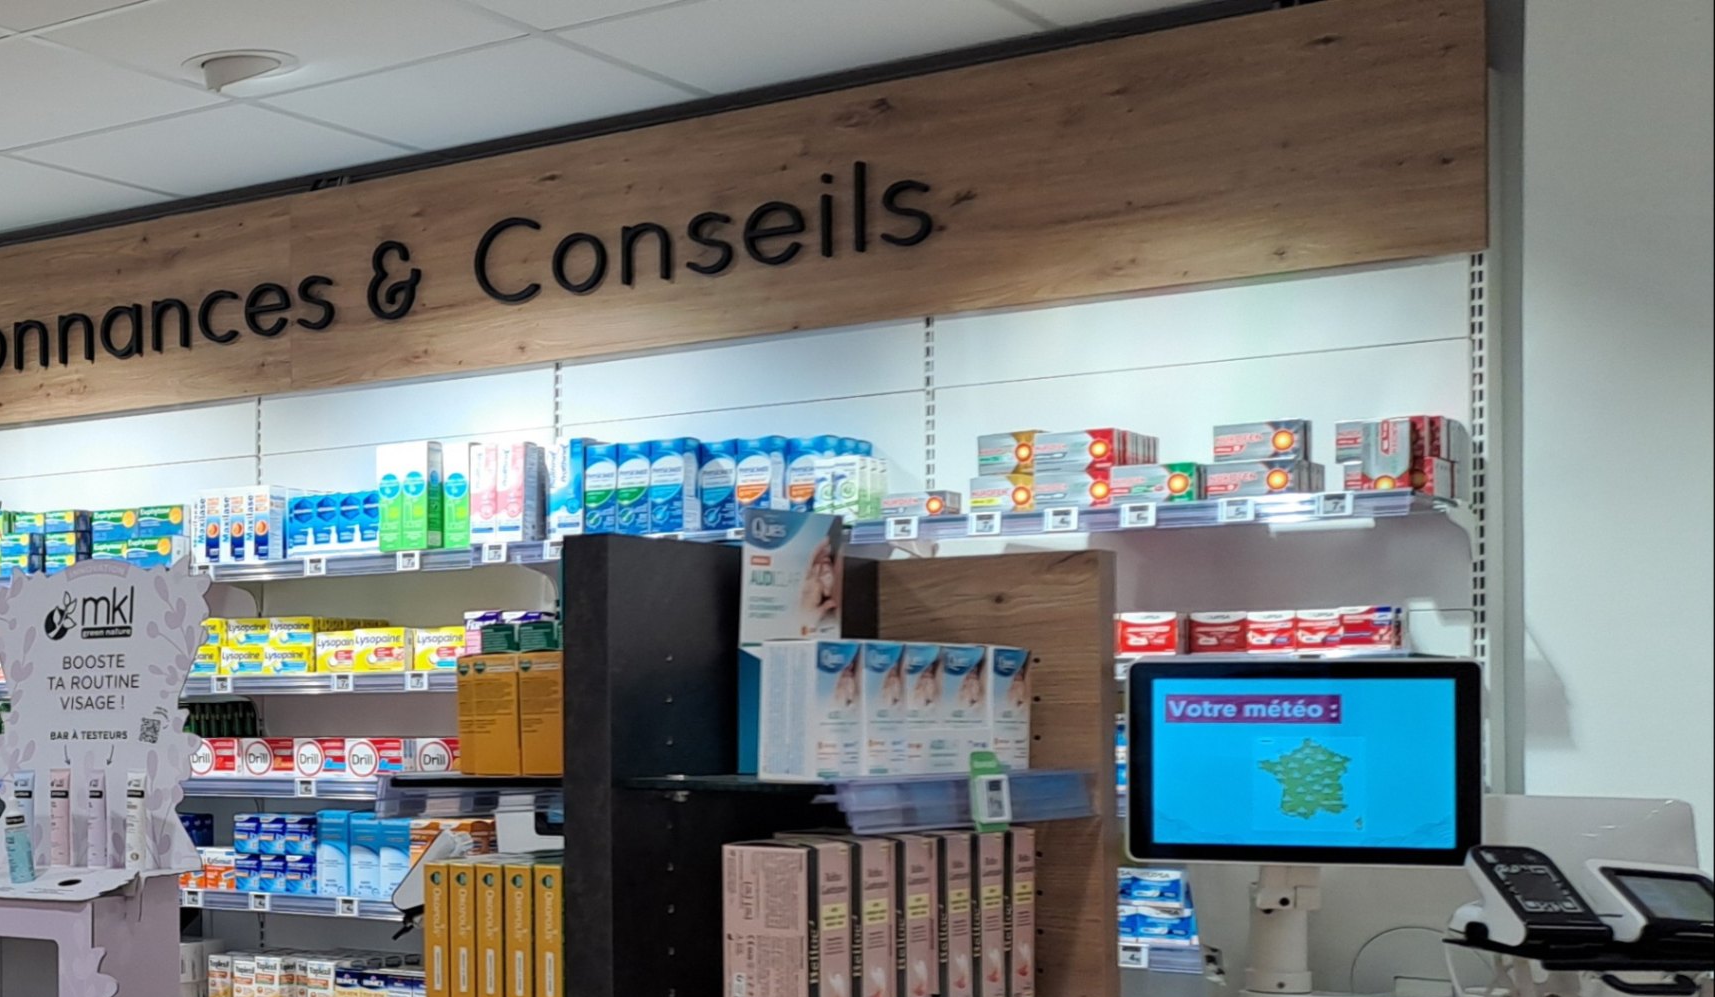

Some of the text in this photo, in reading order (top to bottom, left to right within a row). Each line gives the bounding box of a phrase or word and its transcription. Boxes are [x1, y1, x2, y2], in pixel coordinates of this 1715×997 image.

[366, 238, 422, 322] &
[474, 160, 934, 306] Conseils
[81, 585, 135, 627] mkl
[82, 626, 132, 638] green nature
[228, 621, 267, 634] Lysopaine
[270, 620, 311, 632] Lysopaine
[317, 637, 354, 648] Lysopain
[355, 633, 402, 647] Lysopaine
[416, 632, 464, 645] Lysopaine
[62, 654, 125, 670] BOOSTE
[222, 650, 261, 662] Lysopaine
[264, 650, 305, 662] Lysopaine
[46, 673, 140, 691] TA ROUTINE
[59, 695, 125, 711] VISAGE !
[1168, 698, 1338, 718] Votre météo :
[49, 728, 128, 741] BAR À TESTEURS
[191, 753, 211, 764] Drill
[248, 751, 269, 764] Drill
[299, 753, 319, 765] Drill
[352, 753, 374, 766] Drill
[423, 753, 446, 766] Drill
